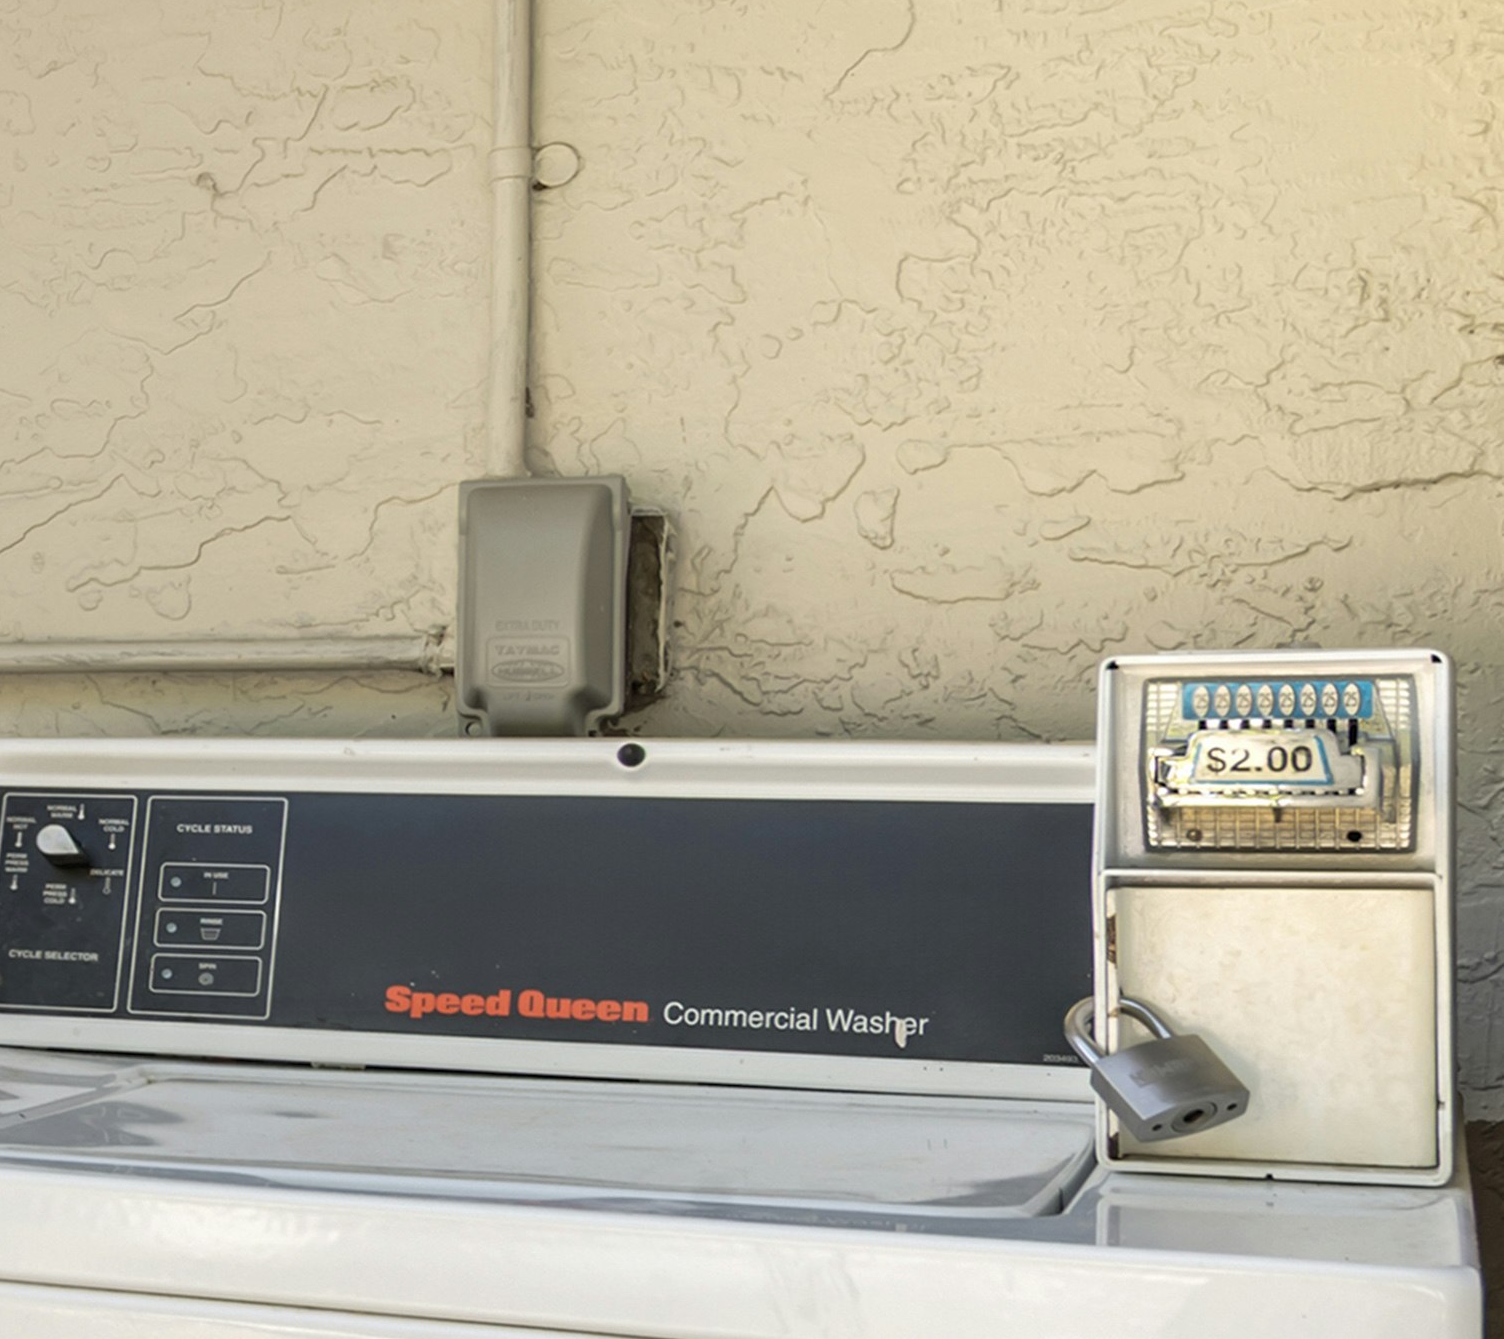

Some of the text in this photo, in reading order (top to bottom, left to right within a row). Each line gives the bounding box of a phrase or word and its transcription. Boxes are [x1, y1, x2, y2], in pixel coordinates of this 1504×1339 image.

[1206, 745, 1313, 774] $2.00
[176, 823, 253, 835] CYCLE STATUS
[8, 948, 99, 962] CYCLE SELECTOR
[385, 984, 929, 1036] Speed Queen Commercial Washer
